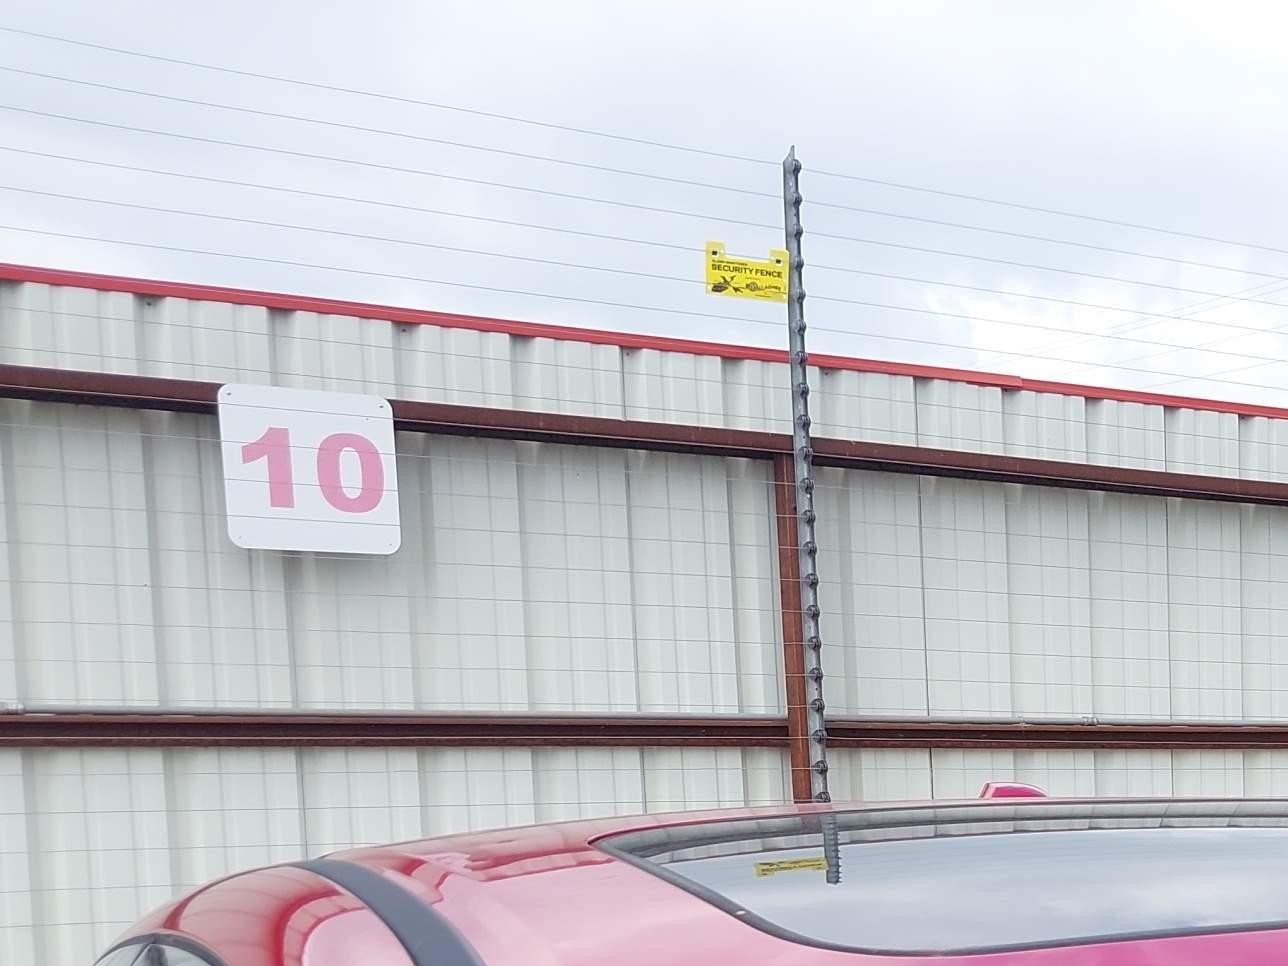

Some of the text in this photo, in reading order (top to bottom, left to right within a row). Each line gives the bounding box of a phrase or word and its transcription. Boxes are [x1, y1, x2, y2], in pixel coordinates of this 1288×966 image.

[711, 263, 783, 279] SECURITY FENCE
[241, 426, 385, 513] 10
